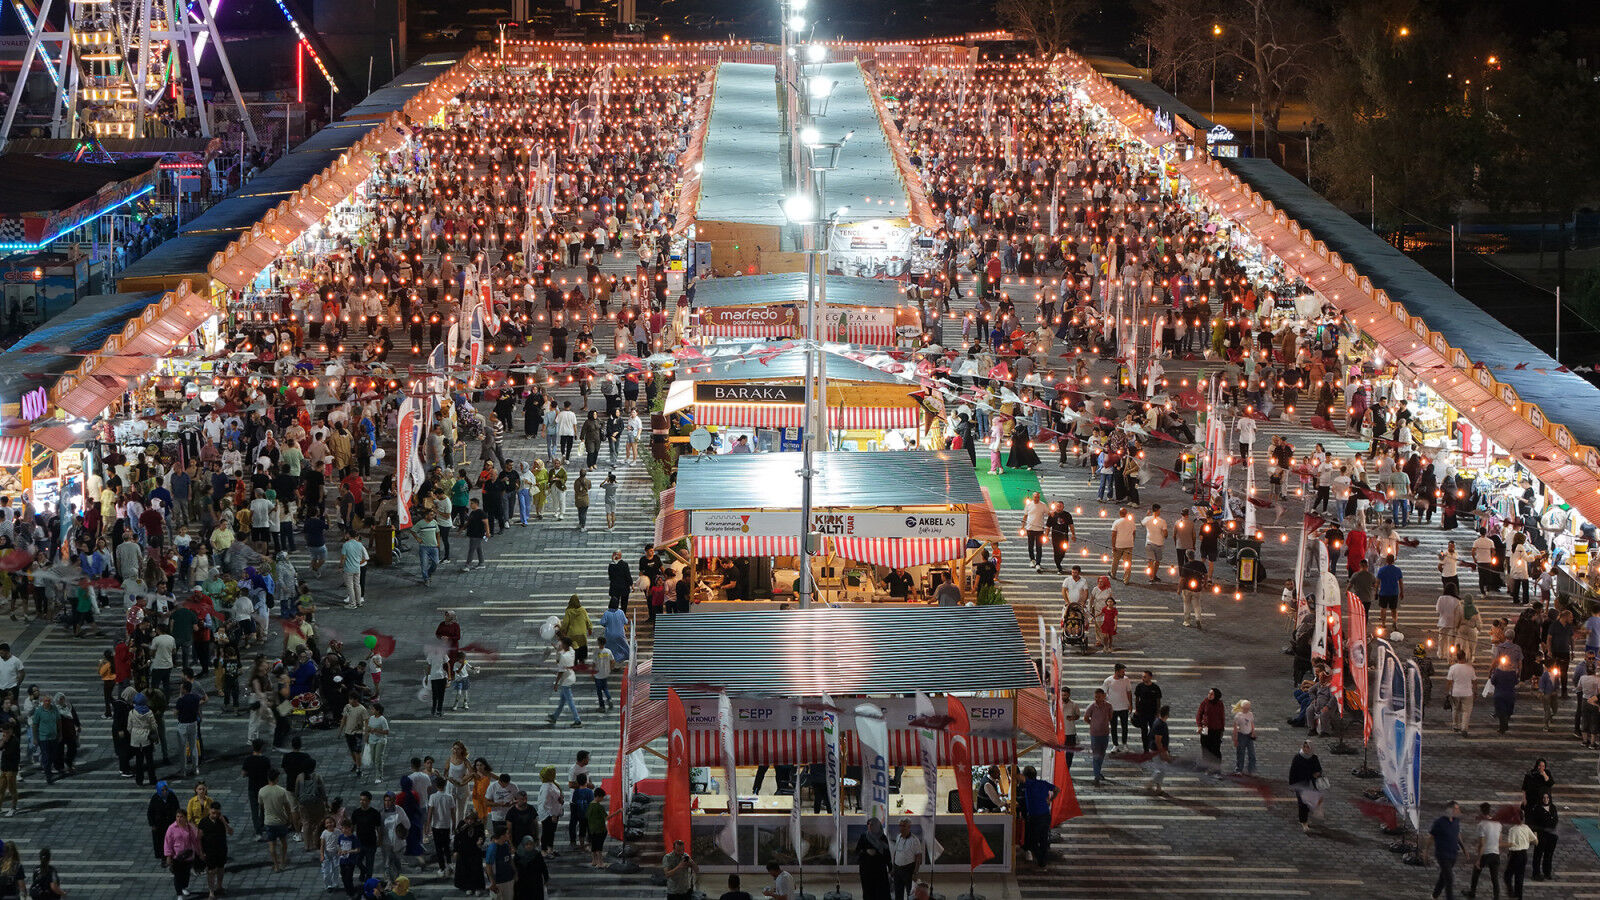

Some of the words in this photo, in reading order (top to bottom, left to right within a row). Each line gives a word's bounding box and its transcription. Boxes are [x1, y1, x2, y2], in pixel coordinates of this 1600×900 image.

[720, 308, 778, 320] marfedo
[715, 387, 787, 399] BARAKA
[815, 515, 844, 524] KIRK
[919, 518, 944, 526] AKBEL
[945, 518, 956, 527] AŞ
[818, 525, 844, 534] ALTI
[751, 708, 773, 719] EPP
[982, 707, 1005, 718] EPP
